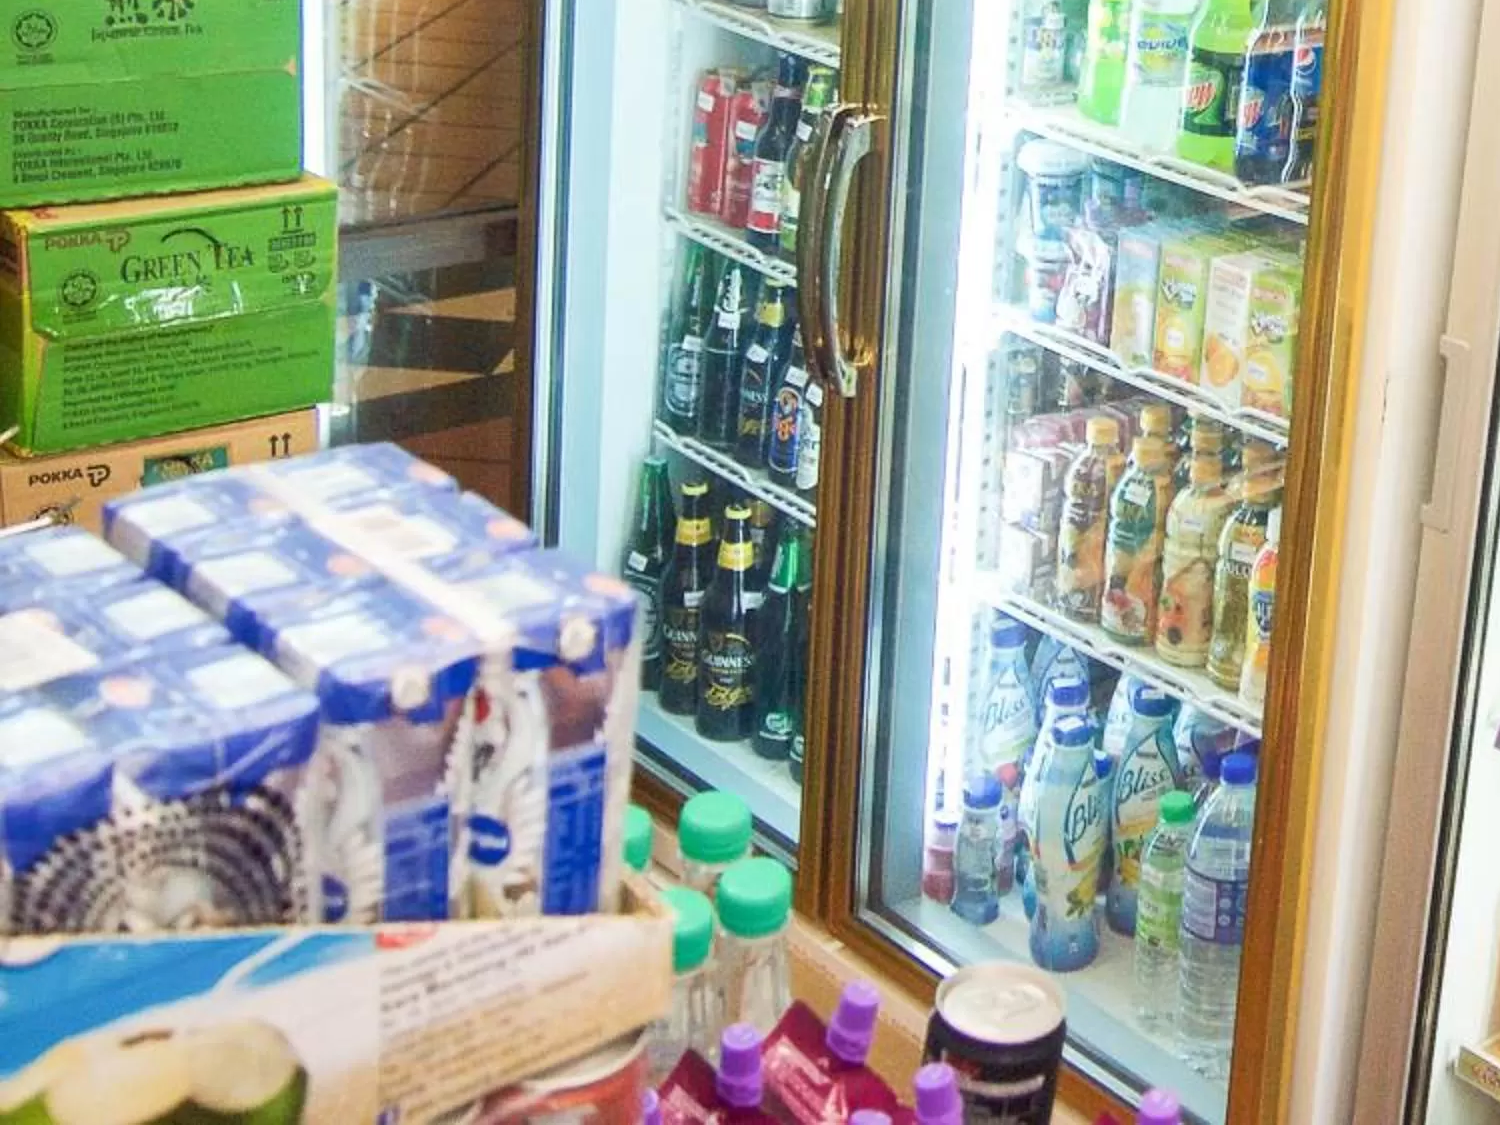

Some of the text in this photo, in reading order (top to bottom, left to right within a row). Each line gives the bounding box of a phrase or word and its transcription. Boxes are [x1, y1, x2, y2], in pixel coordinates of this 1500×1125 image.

[207, 241, 256, 271] TEA
[28, 467, 84, 488] POKKA
[1117, 764, 1172, 804] Bliss
